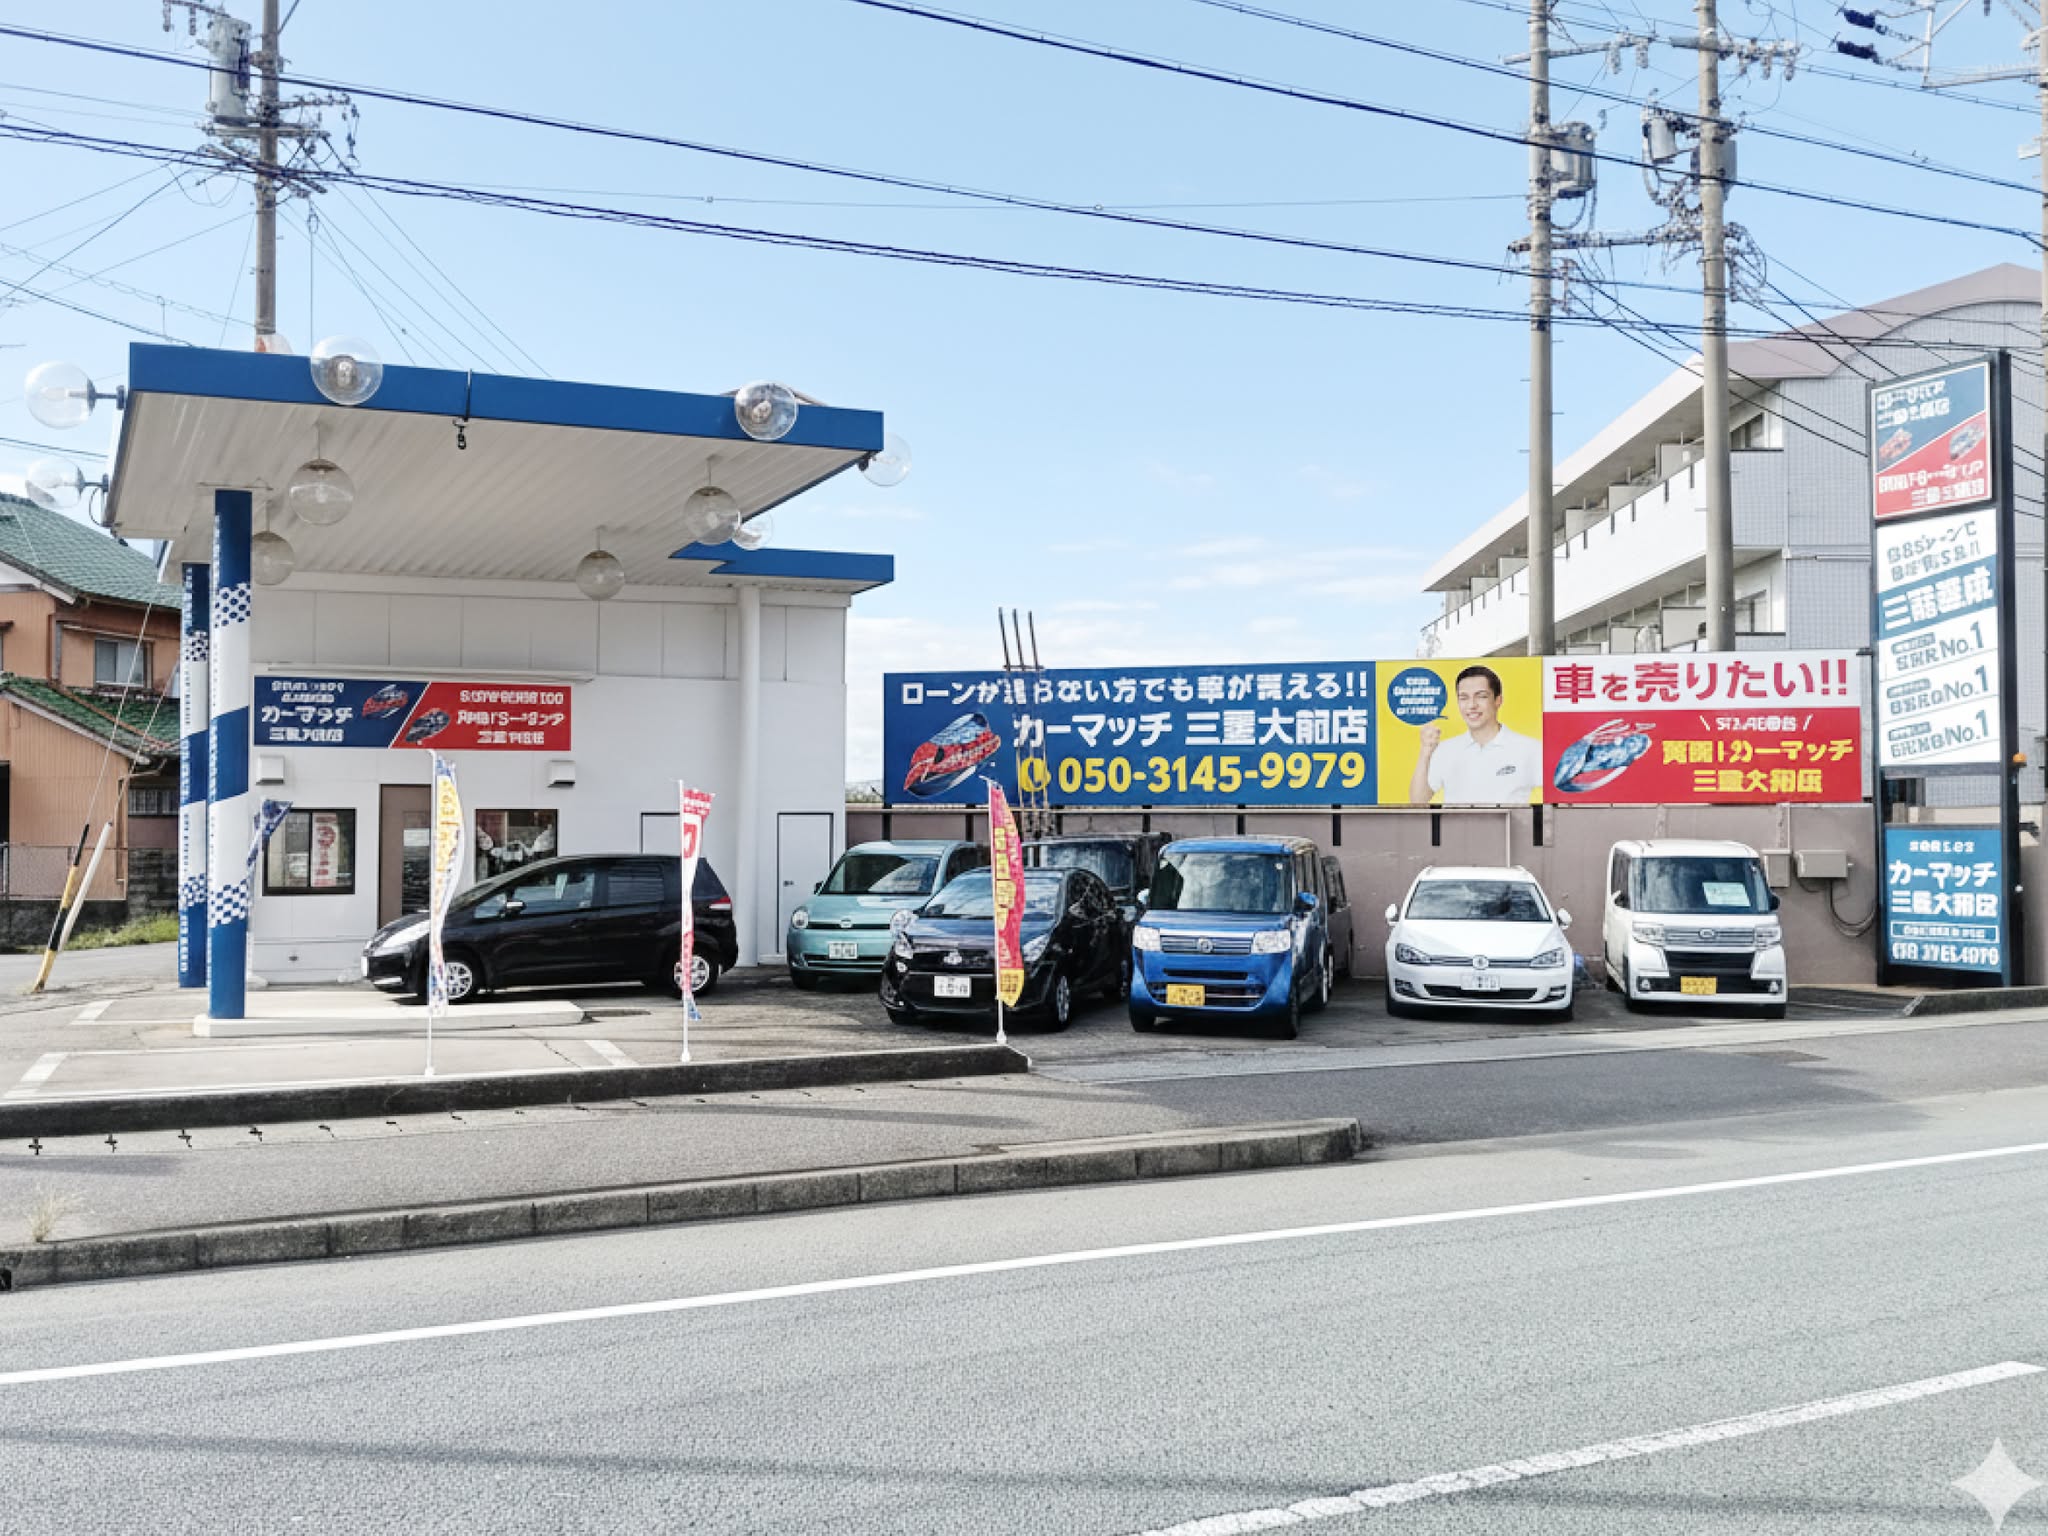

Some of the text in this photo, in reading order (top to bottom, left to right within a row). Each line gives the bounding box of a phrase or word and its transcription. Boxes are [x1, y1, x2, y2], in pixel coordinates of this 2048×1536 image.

[1553, 659, 1848, 704] 車を売りたい!!
[1013, 705, 1369, 748] カーマッチ 三重大前店
[1058, 751, 1366, 794] 050-3145-9979
